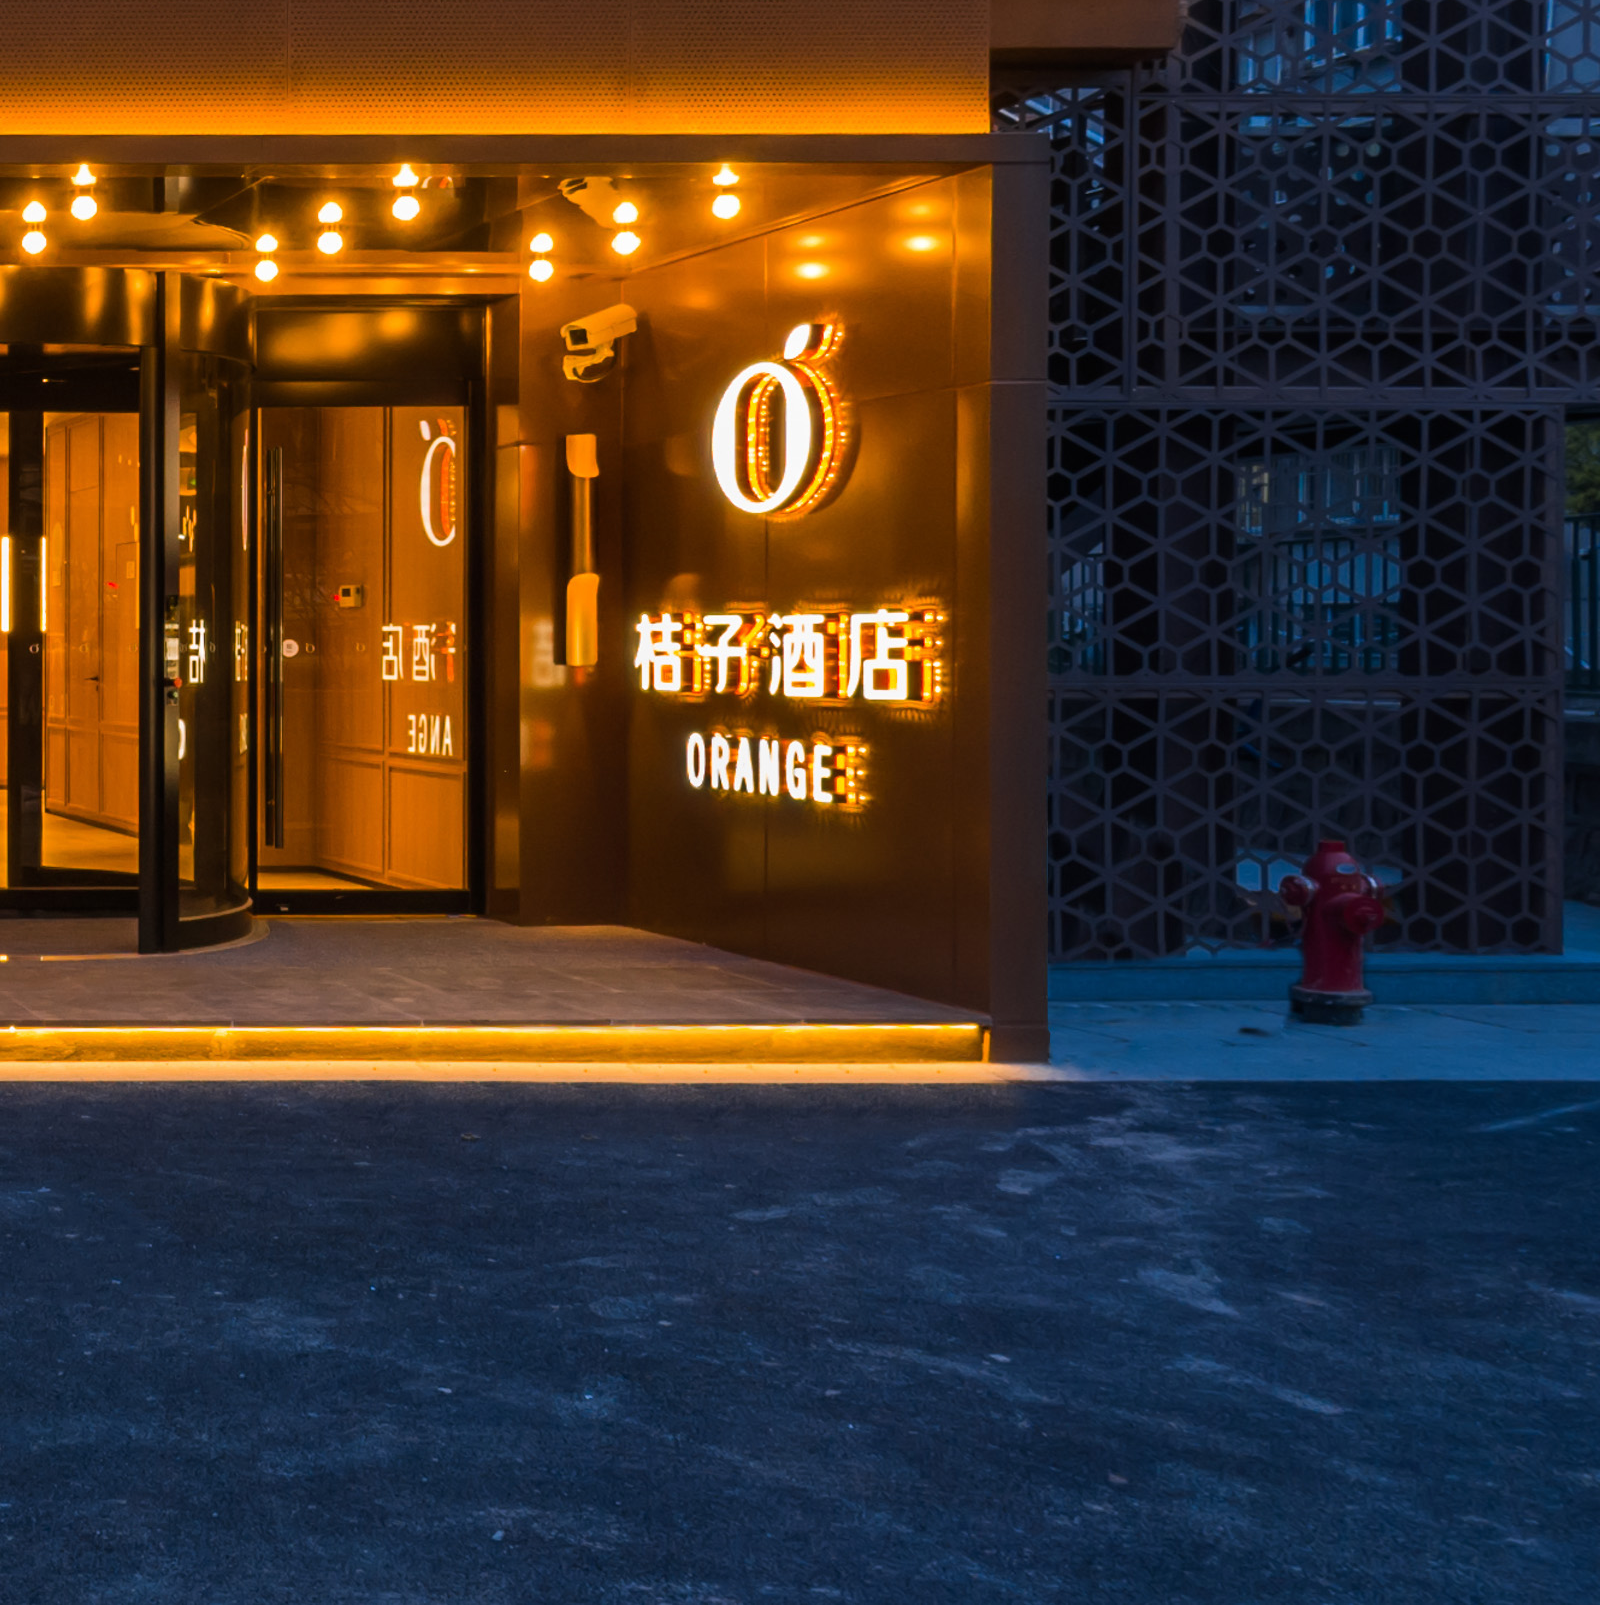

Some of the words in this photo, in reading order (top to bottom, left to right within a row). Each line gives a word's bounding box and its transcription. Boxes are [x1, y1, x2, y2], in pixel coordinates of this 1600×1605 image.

[634, 608, 910, 700] 桔子酒店
[686, 731, 833, 804] ORANGE
